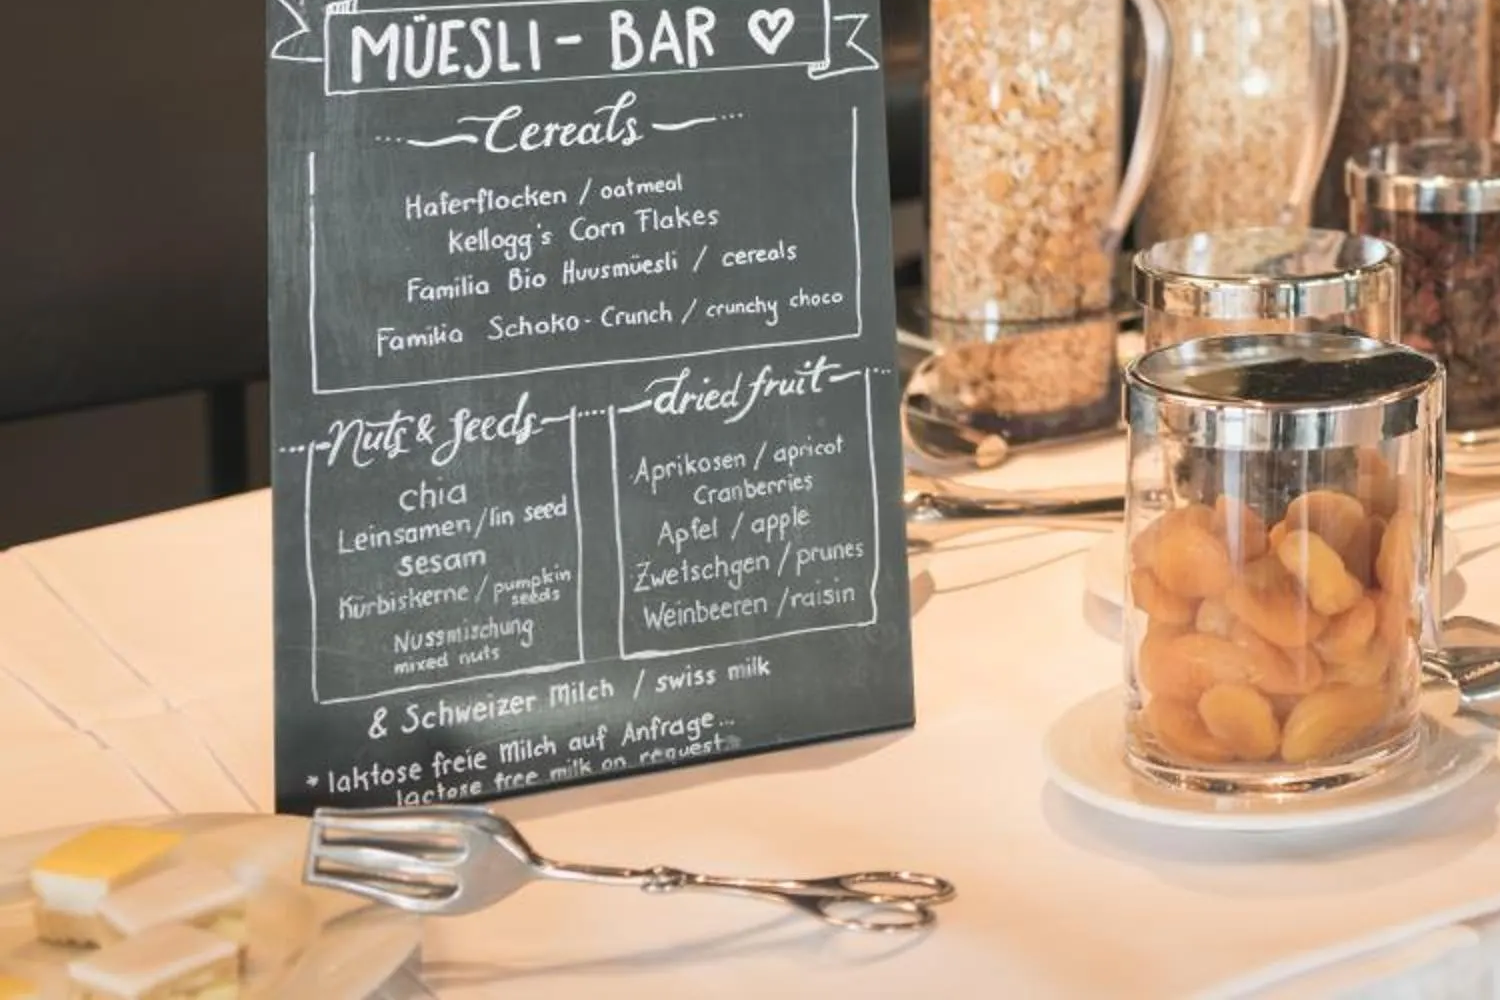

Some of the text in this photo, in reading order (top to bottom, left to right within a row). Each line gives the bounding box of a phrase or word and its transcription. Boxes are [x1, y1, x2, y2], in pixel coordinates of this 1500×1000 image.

[609, 6, 717, 72] BAR
[457, 90, 645, 154] Cereals
[404, 184, 568, 221] Haferflocken
[600, 171, 683, 200] oatmeal
[448, 205, 721, 261] Kellogg's Corn Flakes
[406, 276, 491, 304] Familia
[508, 267, 548, 292] Bio
[561, 249, 679, 286] Huusmüesli
[721, 239, 799, 268] cereals
[376, 322, 464, 358] Familia
[705, 295, 779, 328] crunchy
[788, 286, 844, 309] choco
[644, 354, 842, 425] dried fruit
[633, 452, 747, 496] Aprikosen
[773, 433, 844, 468] apricot
[693, 472, 814, 505] Cranberries
[523, 493, 568, 523] seed
[657, 516, 718, 554] Apfel
[751, 505, 810, 543] apple
[493, 564, 572, 605] pumpkin
[632, 553, 770, 594] Zwetschgen
[795, 540, 865, 577] prunes
[511, 587, 561, 606] seeds
[643, 596, 768, 631] Weinbeeren
[393, 645, 501, 675] mixed nuts
[400, 693, 538, 734] Schweizer
[655, 669, 718, 694] swiss
[727, 654, 772, 681] milk
[327, 762, 423, 793] laktose
[431, 750, 489, 778] freie
[568, 724, 608, 751] auf
[396, 779, 483, 807] lactose
[494, 770, 540, 793] free
[550, 756, 593, 781] milk
[601, 755, 627, 771] on
